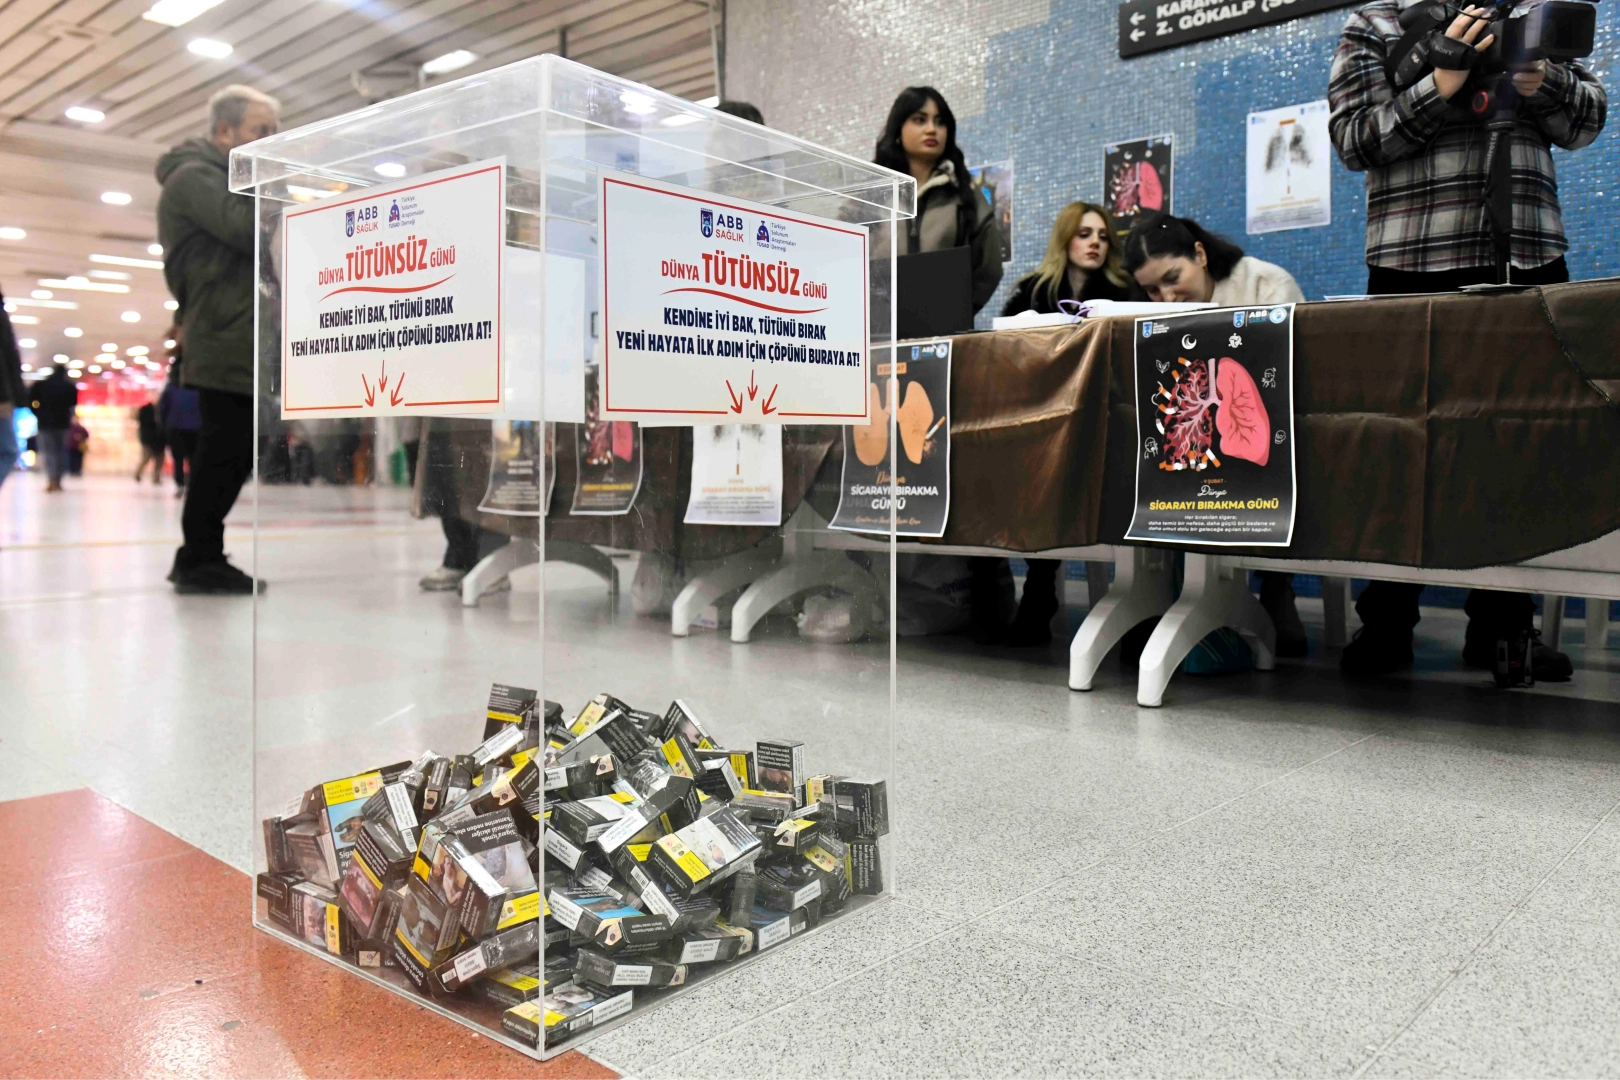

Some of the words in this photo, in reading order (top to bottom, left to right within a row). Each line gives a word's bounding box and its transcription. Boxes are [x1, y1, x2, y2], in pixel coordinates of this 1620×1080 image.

[1156, 22, 1172, 36] Z.
[1179, 1, 1255, 30] GÖKALP
[358, 206, 378, 222] ABB
[717, 214, 743, 230] ABB
[357, 221, 378, 234] SAĞLIK
[716, 229, 744, 242] SAĞLIK
[318, 267, 344, 285] DÜNYA
[346, 235, 427, 281] TÜTÜNSÜZ
[430, 248, 455, 267] GÜNÜ
[661, 260, 699, 281] DÜNYA
[702, 250, 800, 296] TÜTÜNSÜZ
[802, 281, 828, 300] GÜNÜ
[320, 307, 353, 329] KENDİNE
[354, 305, 366, 324] İYİ
[367, 303, 387, 324] BAK,
[389, 299, 423, 319] TÜTÜNÜ
[425, 296, 453, 316] BIRAK
[1249, 310, 1267, 318] ABB
[664, 307, 712, 329] KENDİNE
[715, 310, 730, 329] İYİ
[732, 313, 756, 336] BAK,
[758, 316, 796, 338] TÜTÜNÜ
[799, 321, 826, 340] BIRAK
[291, 340, 308, 356] YENİ
[309, 337, 340, 356] HAYATA
[341, 335, 353, 352] İLK
[355, 333, 376, 351] ADIM
[378, 331, 395, 352] İÇİN
[397, 326, 432, 350] ÇÖPÜNÜ
[435, 323, 473, 344] BURAYA
[476, 321, 491, 340] AT!
[616, 330, 645, 350] YENİ
[648, 333, 694, 354] HAYATA
[697, 335, 714, 356] İLK
[716, 339, 744, 358] ADIM
[746, 340, 766, 362] İÇİN
[768, 343, 807, 364] ÇÖPÜNÜ
[809, 349, 844, 366] BURAYA
[846, 352, 860, 367] AT!
[851, 484, 891, 495] SİGARAYI
[896, 486, 938, 495] BIRAKMA
[1197, 485, 1227, 498] Dünya
[1149, 500, 1195, 510] SİGARAYI
[1198, 500, 1245, 510] BIRAKMA
[1247, 498, 1279, 509] GÜNÜ
[339, 850, 353, 859] Siga
